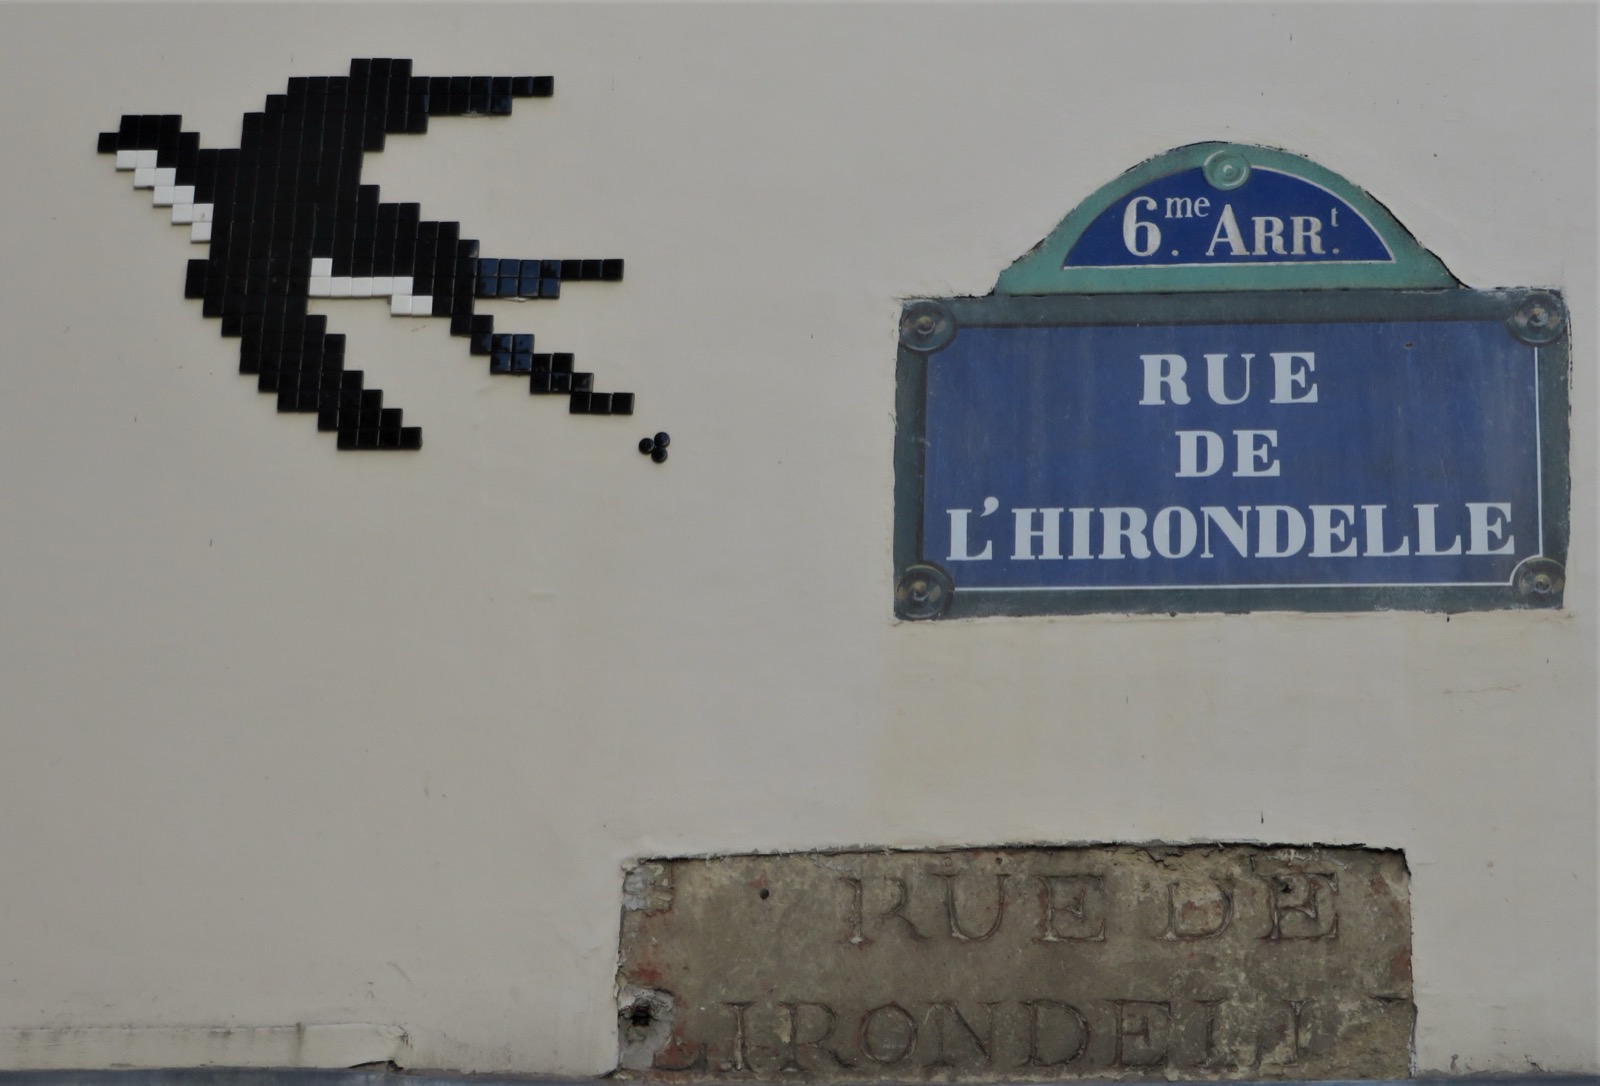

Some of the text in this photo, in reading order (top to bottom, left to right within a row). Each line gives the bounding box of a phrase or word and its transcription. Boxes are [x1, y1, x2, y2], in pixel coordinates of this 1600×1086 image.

[1138, 351, 1320, 406] RUE
[1174, 429, 1281, 478] DE
[946, 496, 1516, 562] L'HIRONDELLE
[839, 870, 1339, 942] RUE DE
